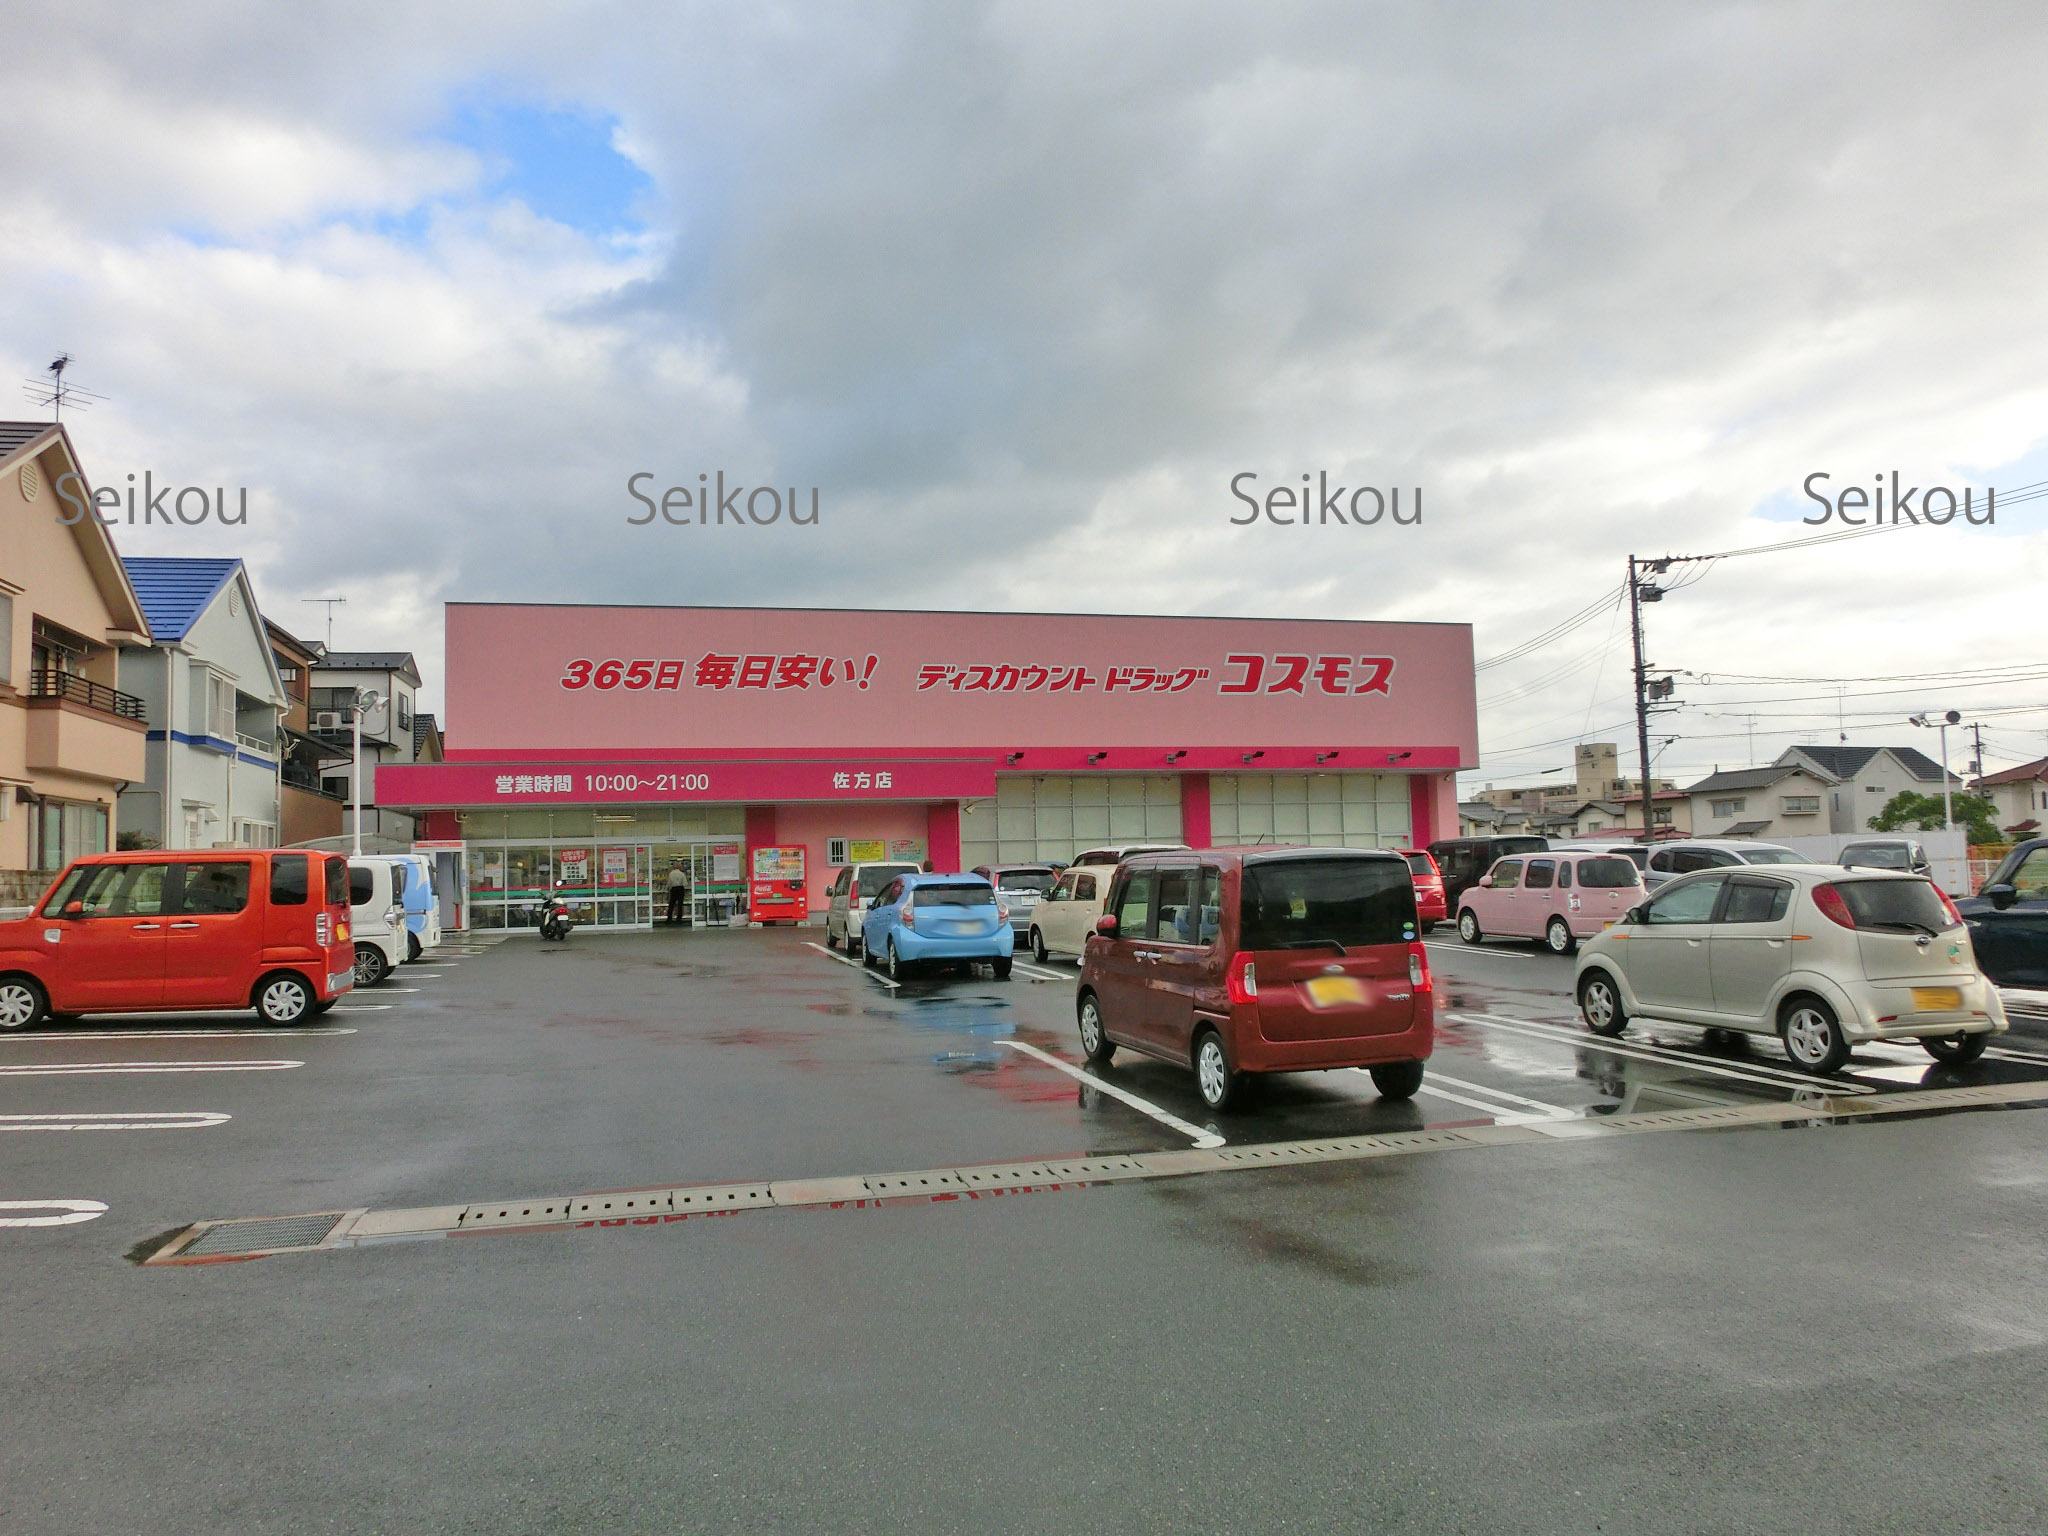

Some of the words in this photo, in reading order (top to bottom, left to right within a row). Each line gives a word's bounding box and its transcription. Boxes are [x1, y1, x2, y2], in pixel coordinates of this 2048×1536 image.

[561, 657, 687, 690] 365日
[917, 663, 1097, 693] ディスカウント
[1103, 665, 1210, 693] ドラッグ
[1218, 653, 1396, 698] コスモス
[495, 775, 573, 793] 営業時間
[833, 772, 893, 790] 佐方店
